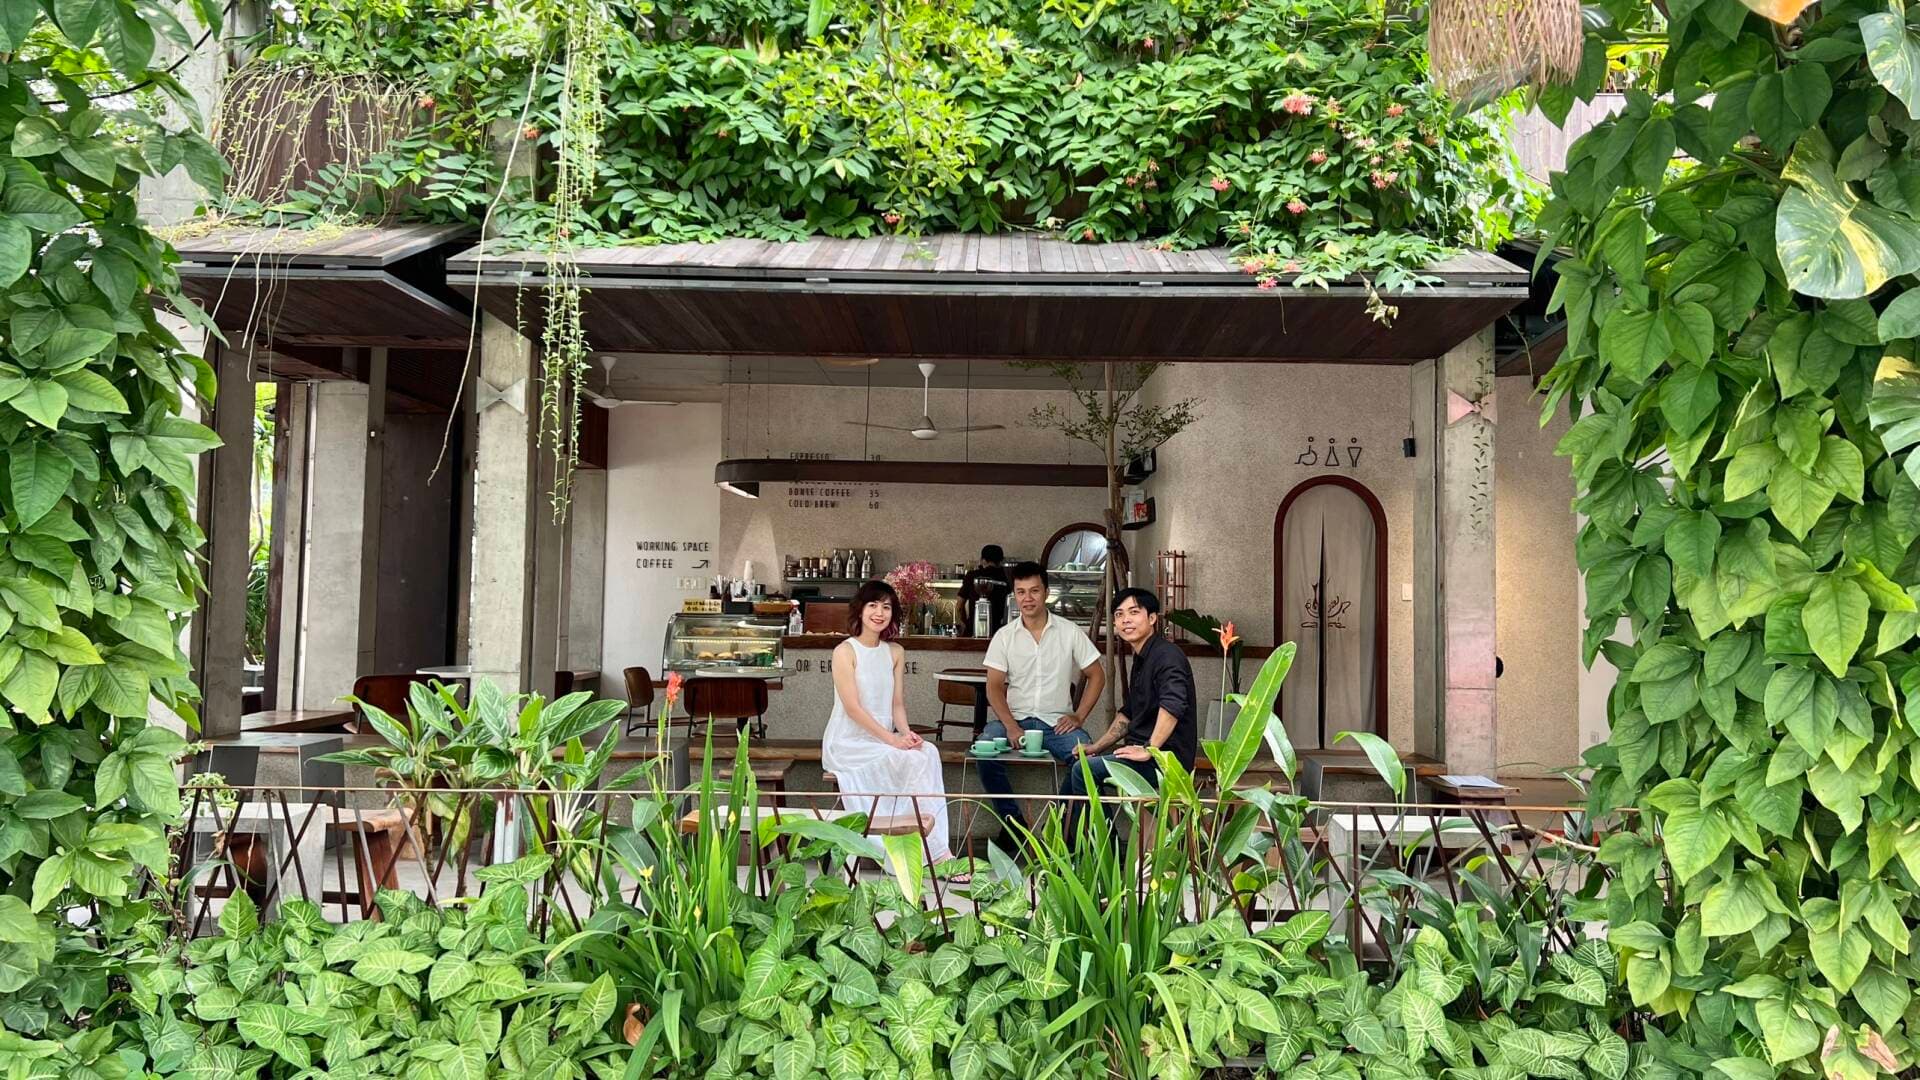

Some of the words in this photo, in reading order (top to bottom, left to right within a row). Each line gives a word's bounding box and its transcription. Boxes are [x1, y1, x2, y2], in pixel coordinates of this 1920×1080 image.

[821, 488, 851, 497] COFFEE
[869, 489, 880, 498] 35
[789, 499, 810, 508] COLD
[815, 500, 836, 509] BREW
[636, 541, 677, 552] WORKING
[682, 541, 709, 552] SPACE
[636, 558, 673, 569] COFFEE
